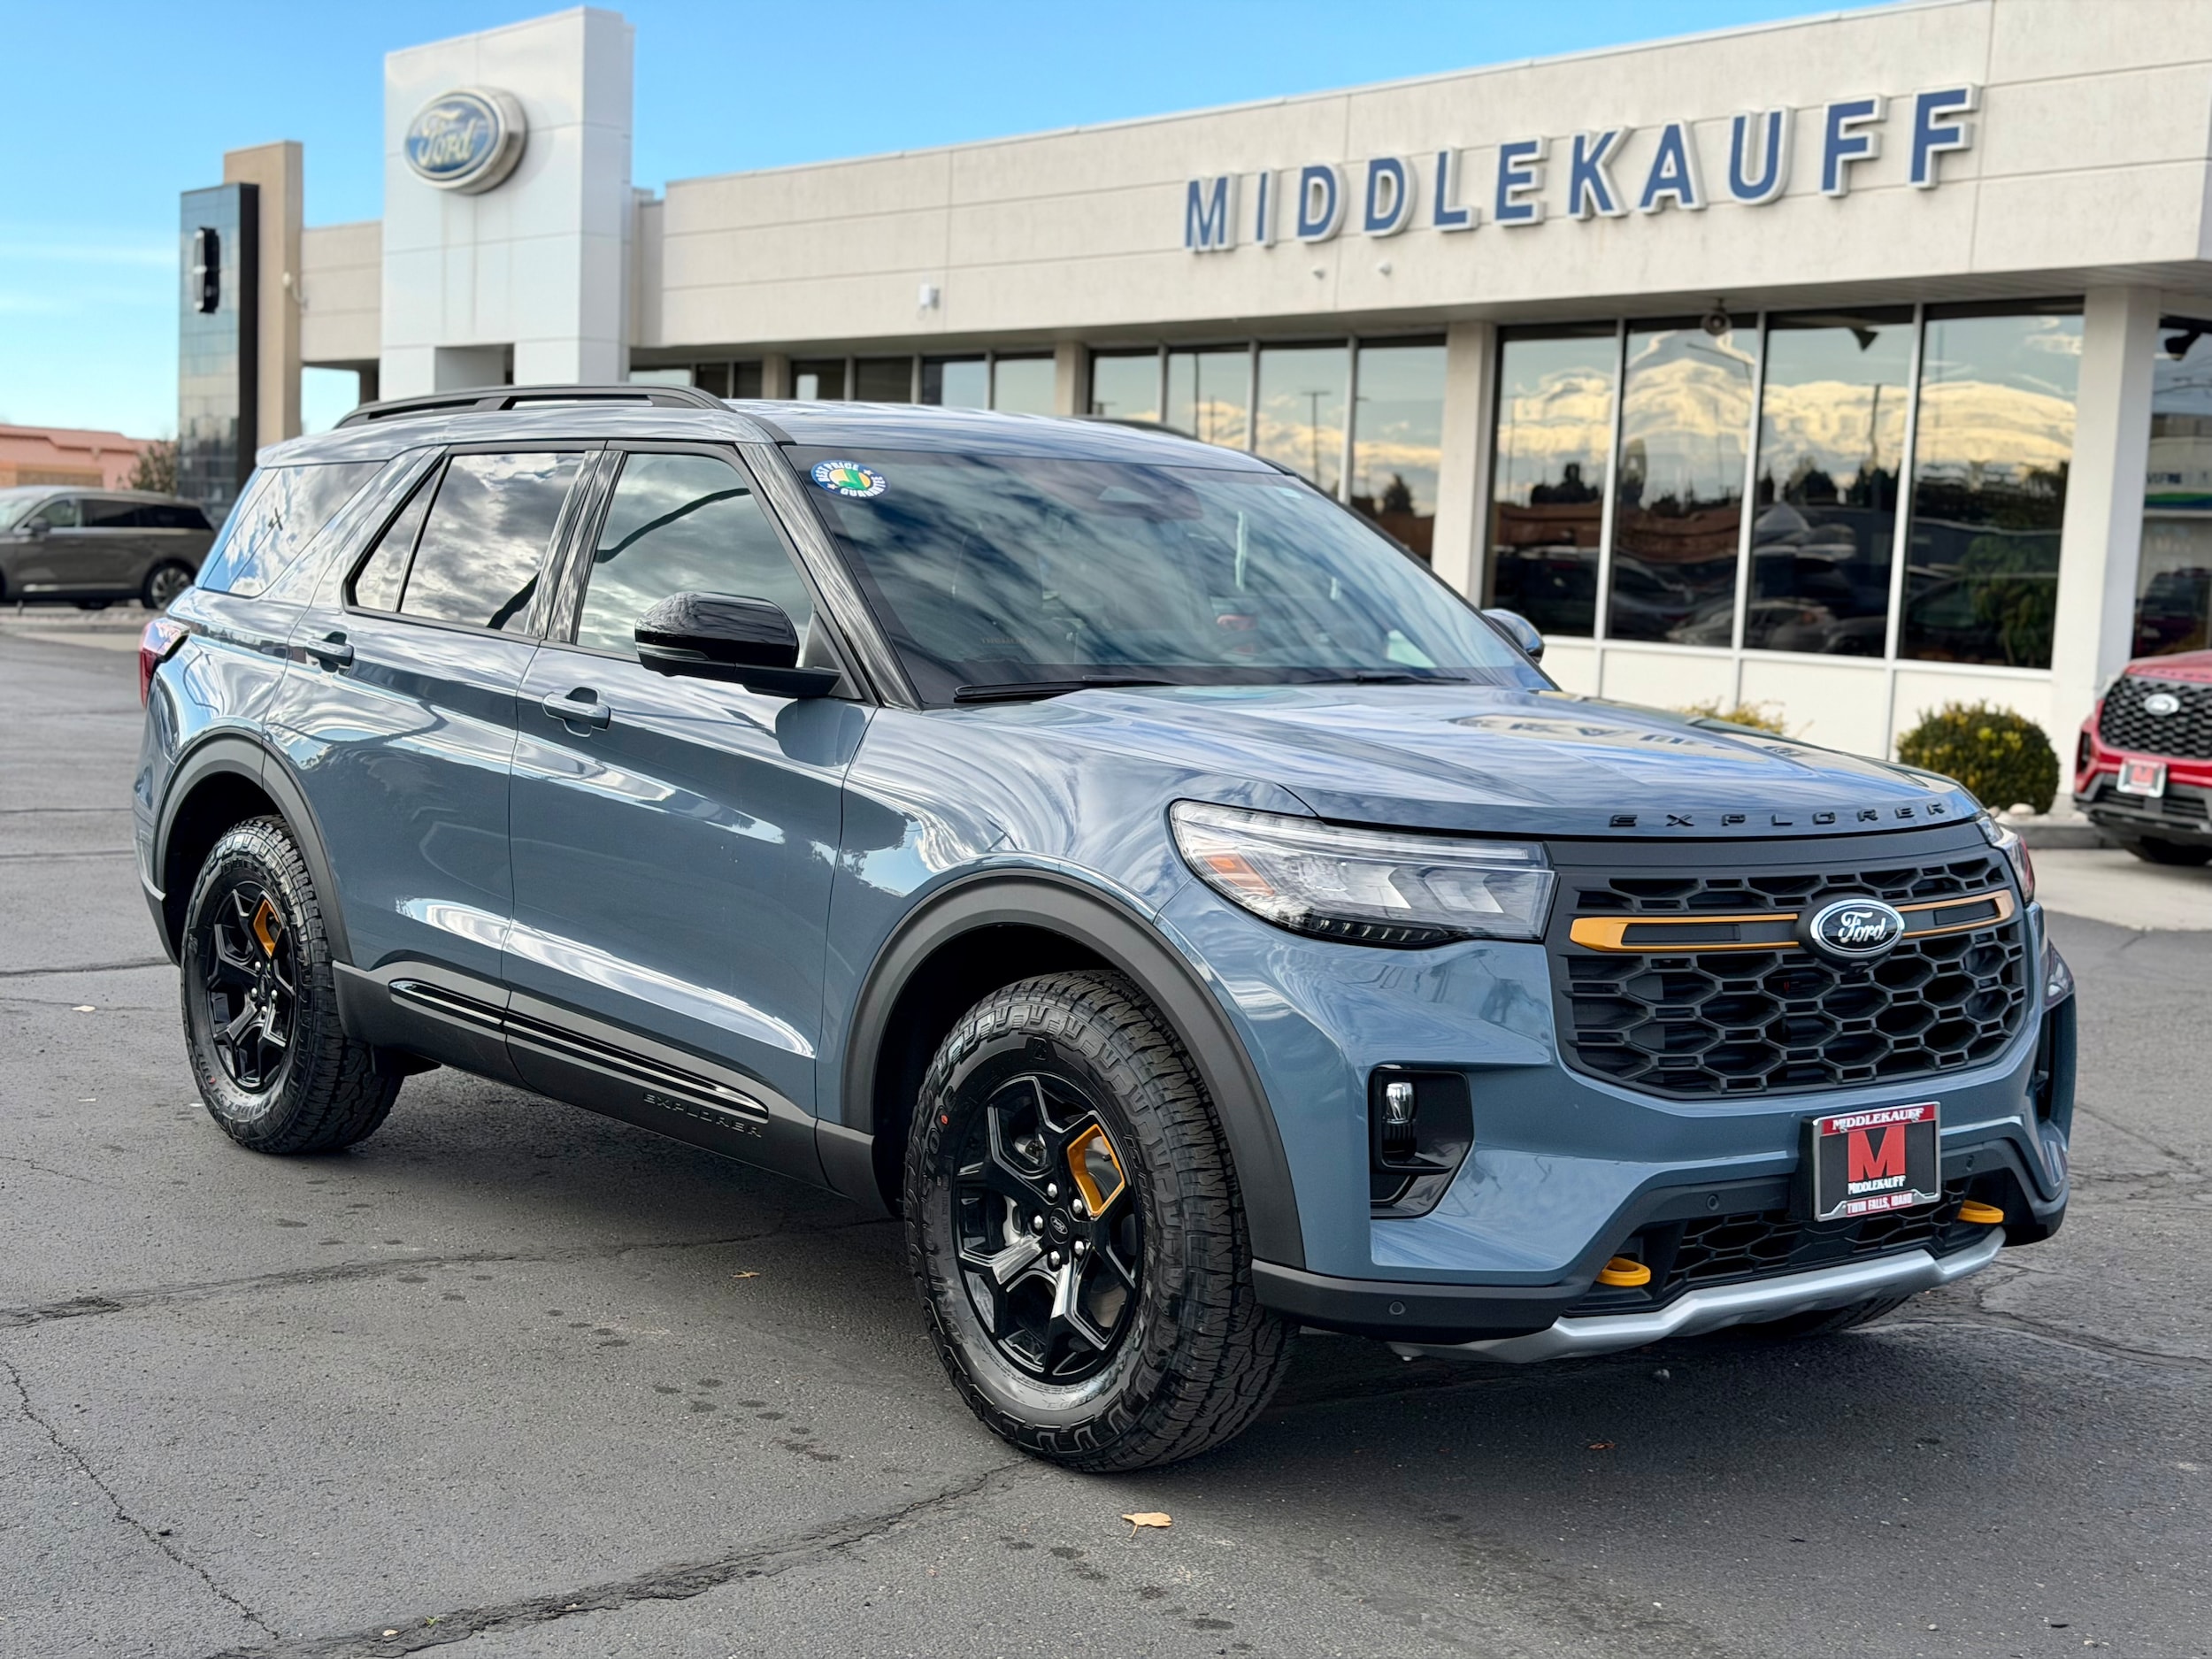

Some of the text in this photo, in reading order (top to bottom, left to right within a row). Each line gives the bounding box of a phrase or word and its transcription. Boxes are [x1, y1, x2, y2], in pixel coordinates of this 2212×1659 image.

[417, 108, 478, 167] Ford
[1183, 83, 1981, 254] MIDDLEKAUFF
[815, 461, 860, 482] BEST PRICE
[840, 476, 887, 497] GUARANTEE
[1609, 803, 1946, 827] EXPLORER
[1838, 911, 1887, 943] Ford
[643, 1092, 762, 1138] EXPLORER
[1832, 1108, 1924, 1131] MIDDLEKAUFF
[1847, 1125, 1906, 1182] M
[1847, 1175, 1906, 1194] MIDDLEKAUFF
